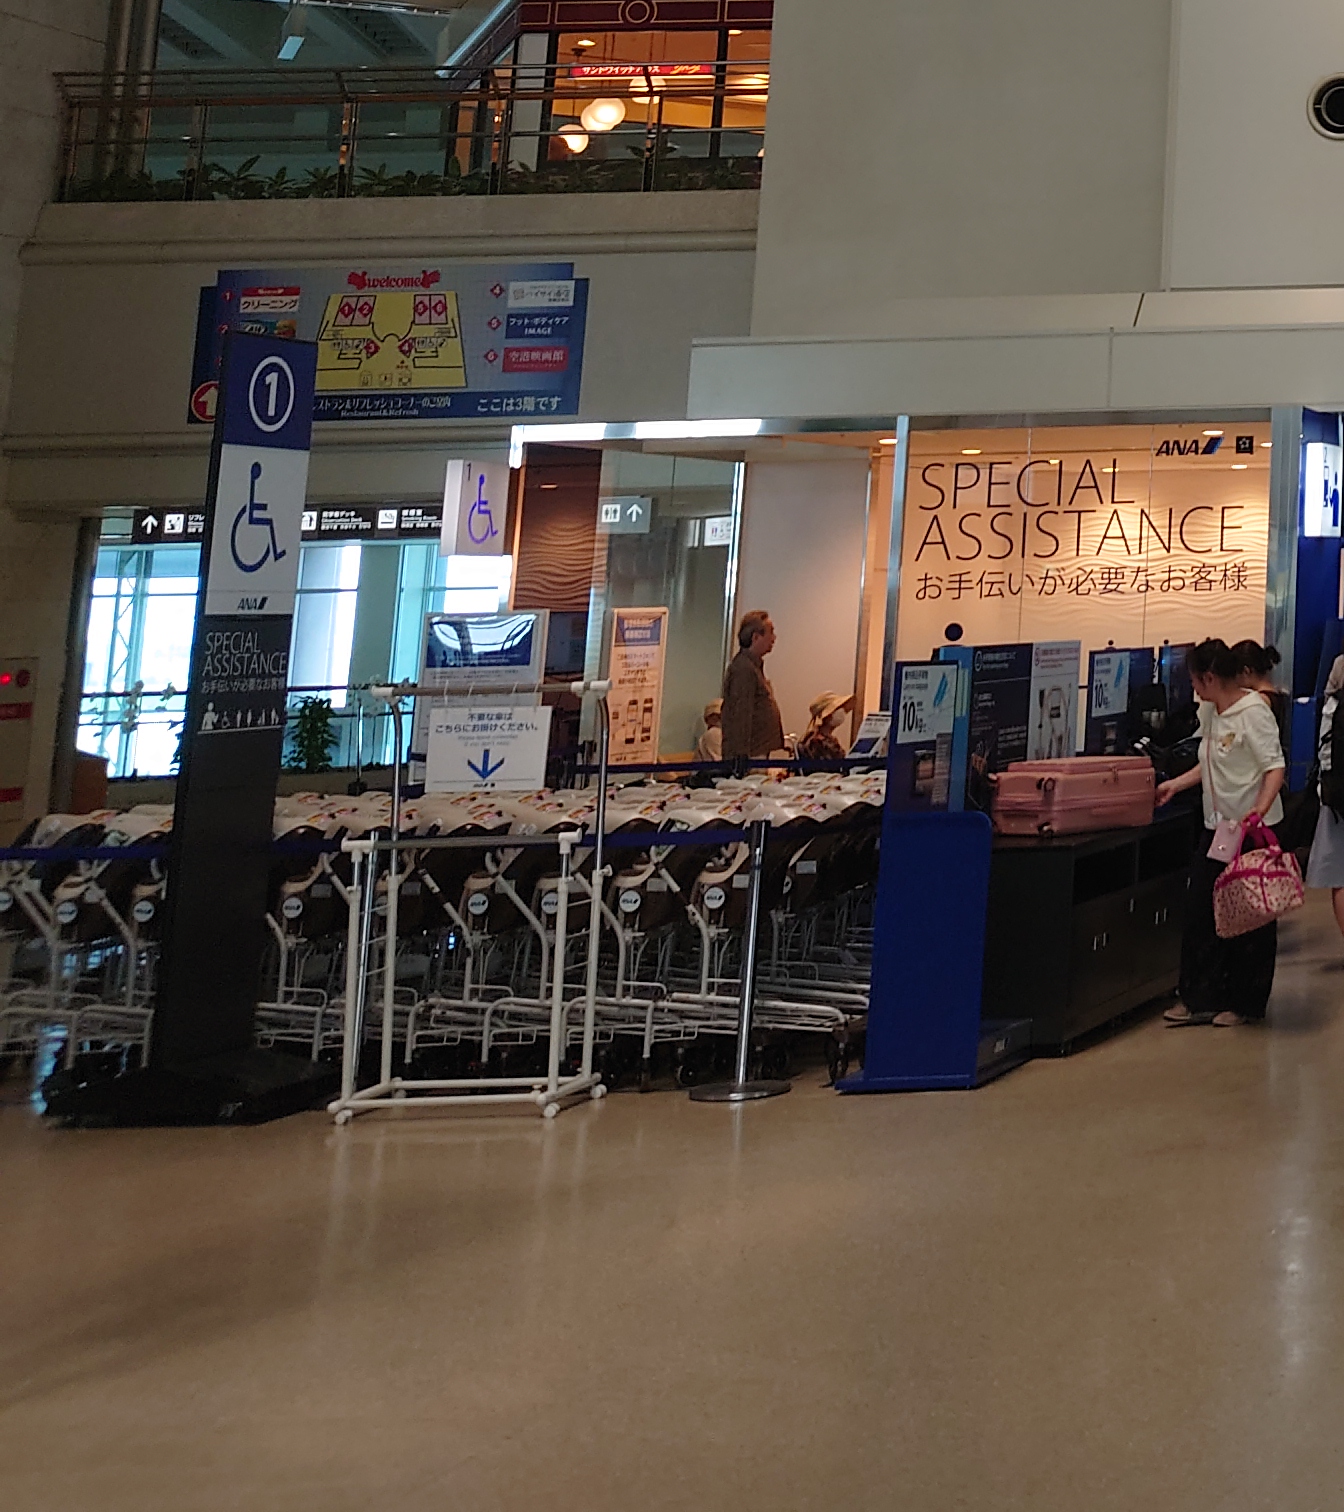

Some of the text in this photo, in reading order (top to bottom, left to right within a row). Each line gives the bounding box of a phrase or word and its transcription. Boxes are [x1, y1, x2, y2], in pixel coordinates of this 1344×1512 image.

[366, 274, 421, 287] welcome
[241, 298, 298, 310] クリーニング
[525, 327, 552, 335] IMAGE
[478, 396, 561, 412] ここは3階です
[1156, 439, 1199, 456] ANA
[919, 458, 1135, 511] SPECIAL
[915, 505, 1244, 562] ASSISTANCE
[915, 561, 1248, 600] お手伝いが必要なお客様
[238, 597, 258, 610] ANA
[205, 632, 261, 654] SPECIAL
[202, 652, 287, 676] ASSISTANCE
